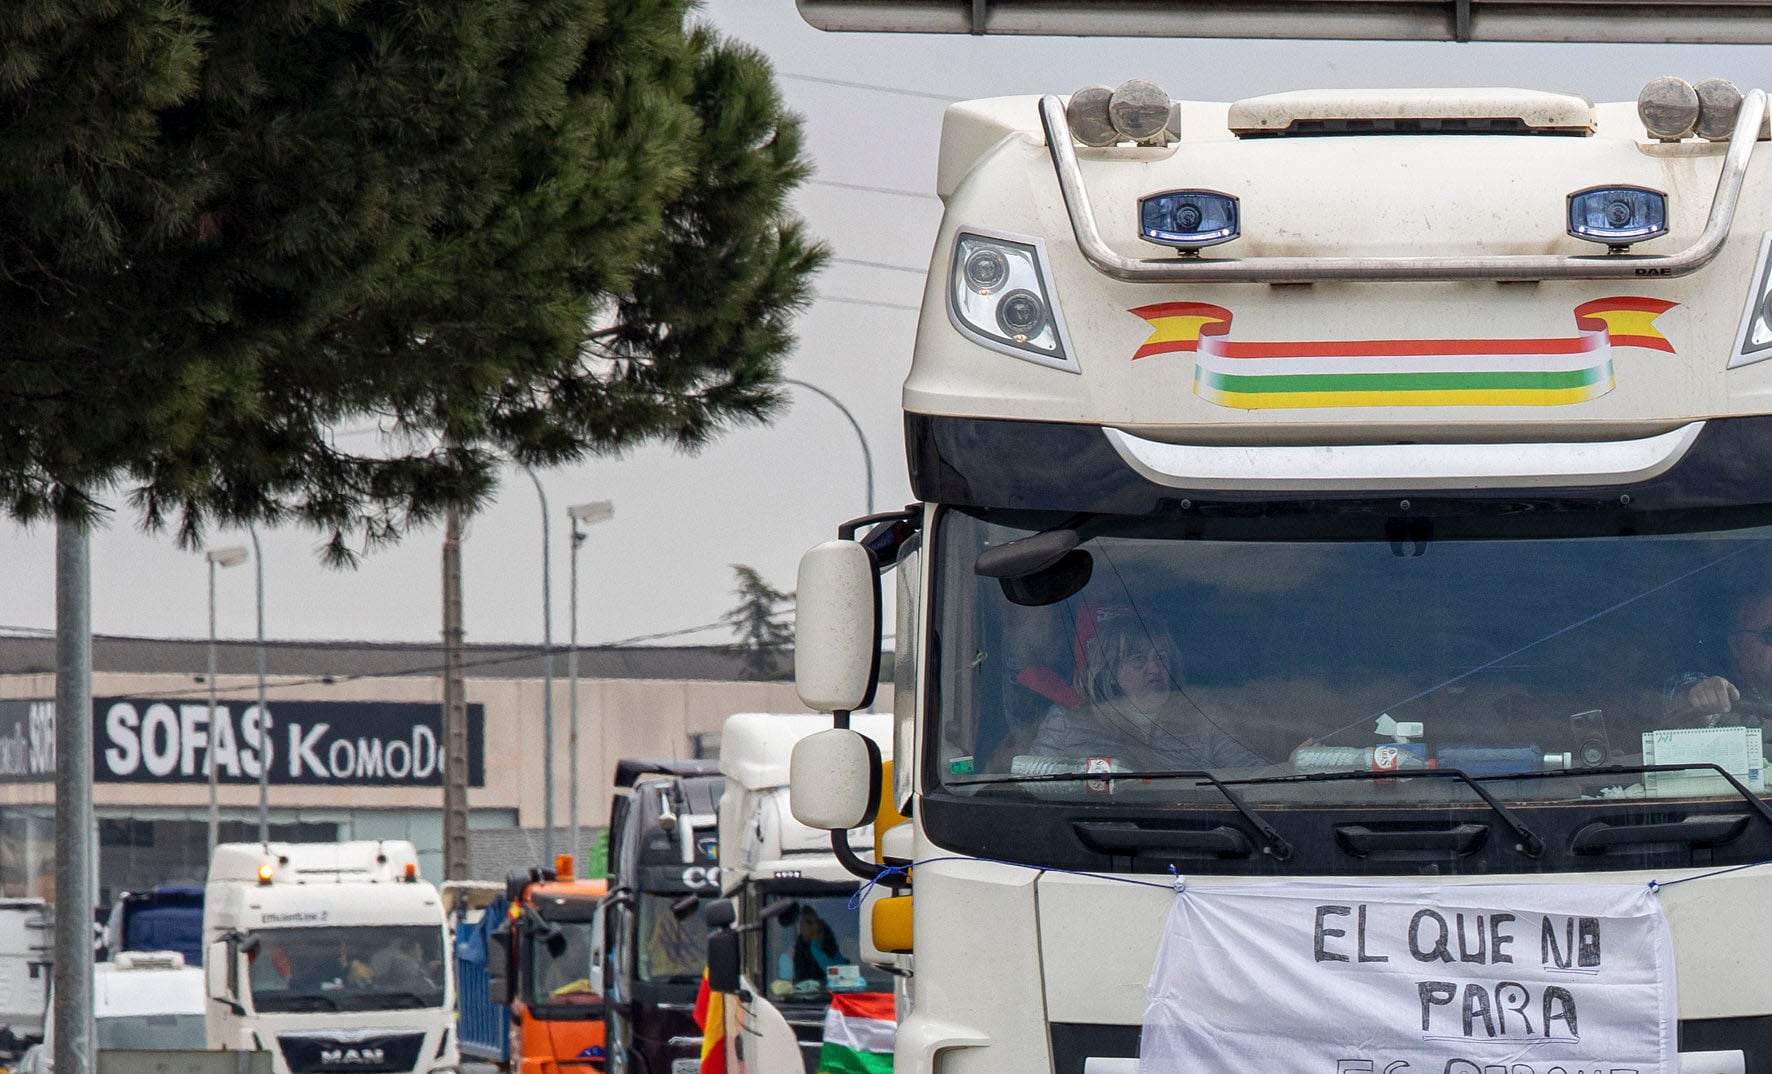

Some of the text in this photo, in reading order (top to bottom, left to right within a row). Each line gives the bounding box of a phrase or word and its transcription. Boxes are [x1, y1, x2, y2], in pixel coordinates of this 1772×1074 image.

[105, 702, 274, 777] SOFAS
[1313, 904, 1600, 969] EL QUE NO
[1415, 981, 1580, 1038] PARA
[321, 1049, 384, 1064] MAN
